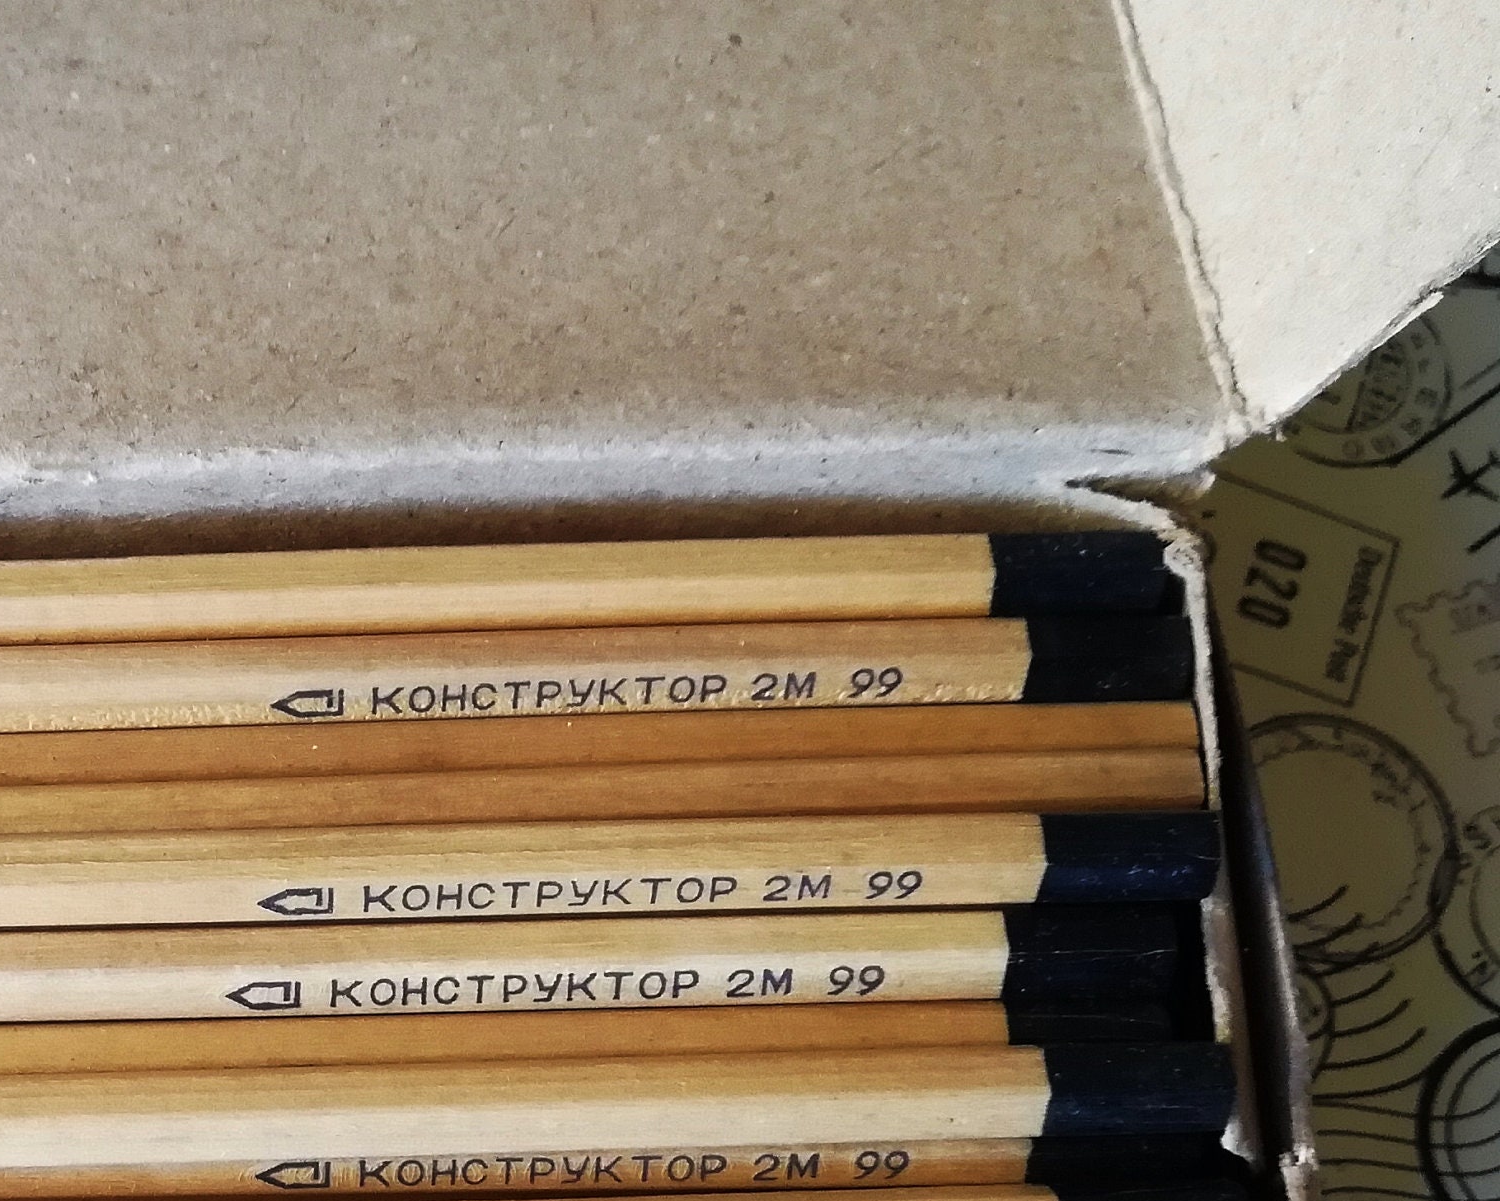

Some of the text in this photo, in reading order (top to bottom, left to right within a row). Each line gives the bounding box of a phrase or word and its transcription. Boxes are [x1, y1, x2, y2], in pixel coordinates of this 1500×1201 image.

[1237, 537, 1307, 630] 020
[370, 673, 727, 716] КОНСТРУКТОР
[848, 666, 903, 699] 99
[362, 875, 739, 913] КОНСТРУКТОР
[866, 869, 924, 901] 99
[328, 969, 700, 1009] КОНСТРУКТОР
[826, 963, 886, 997] 99
[358, 1153, 728, 1189] КОНСТРУКТОР
[852, 1148, 911, 1180] 99
